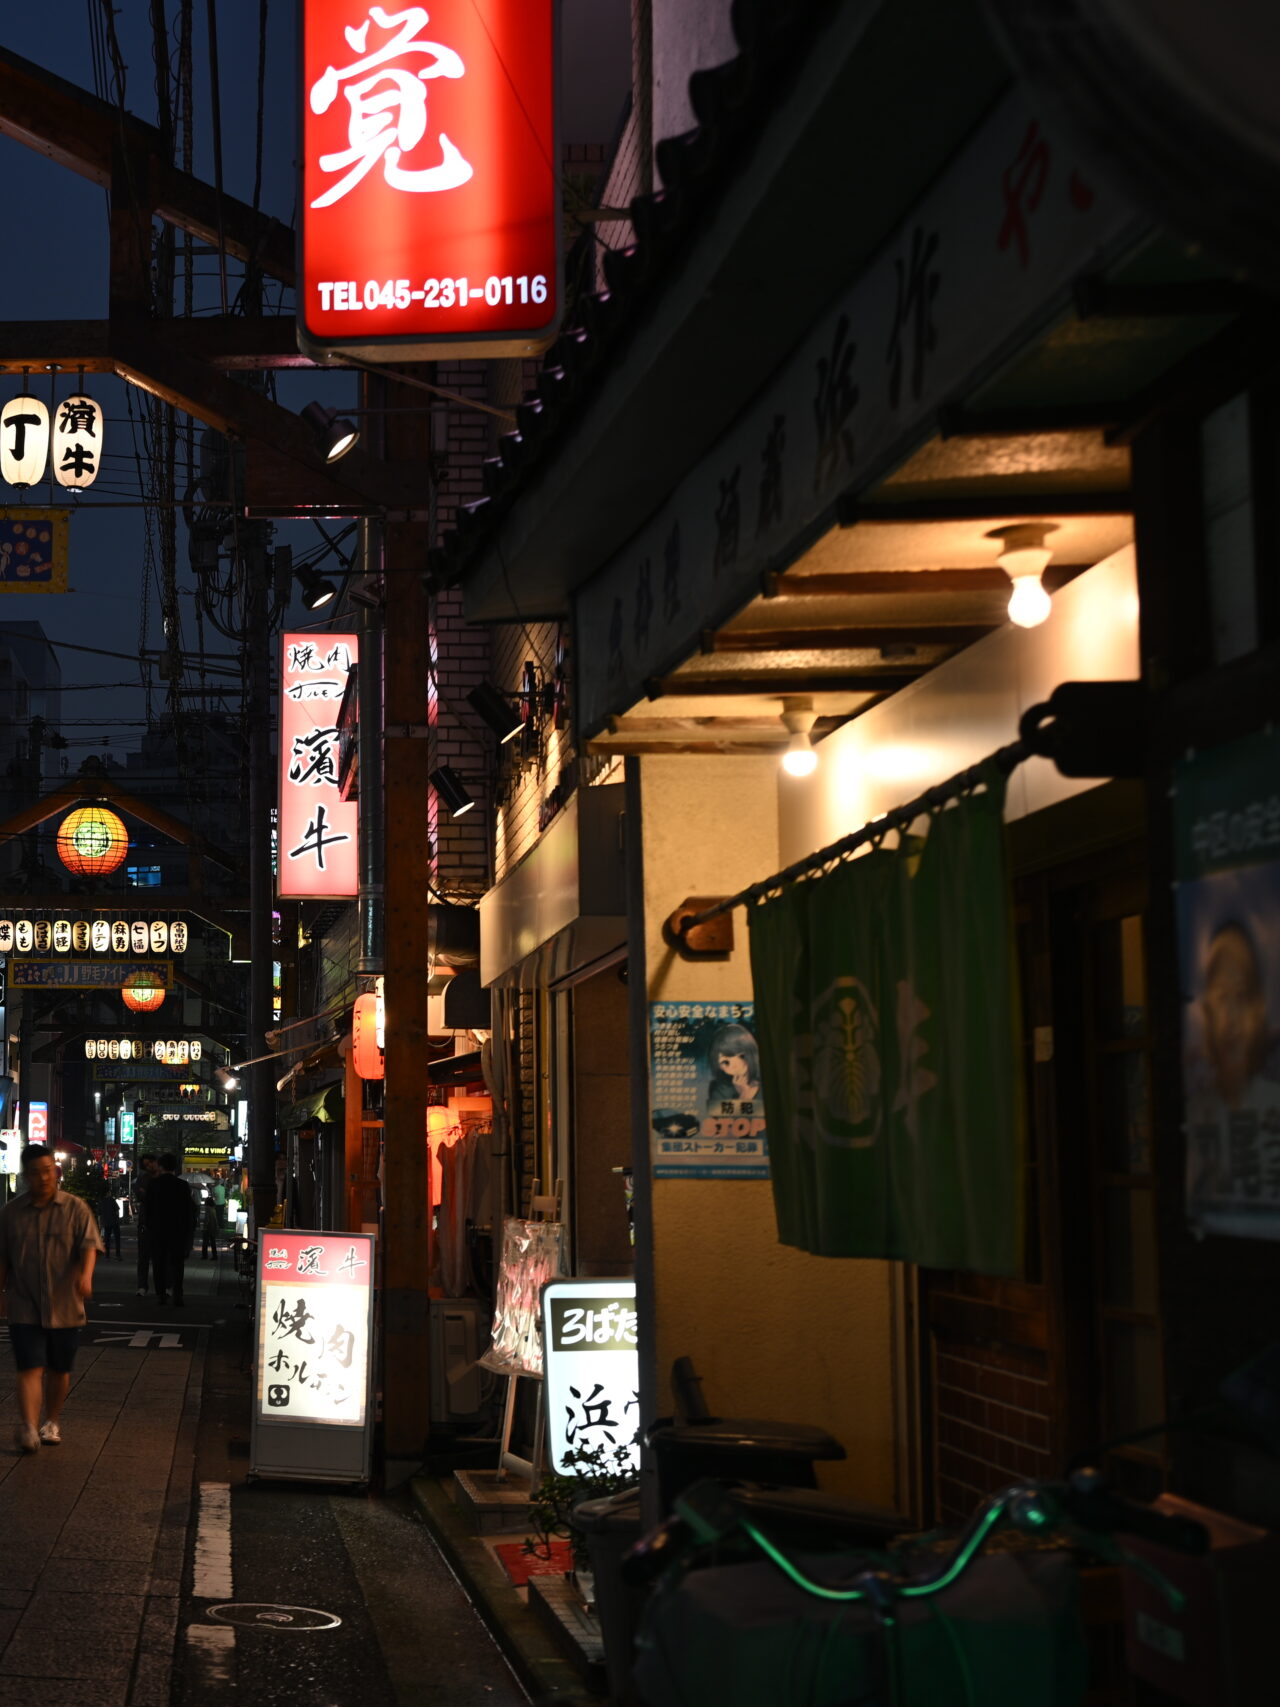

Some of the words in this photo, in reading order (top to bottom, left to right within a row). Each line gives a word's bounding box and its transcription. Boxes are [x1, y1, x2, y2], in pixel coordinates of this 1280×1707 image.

[310, 6, 473, 208] 覚
[318, 275, 548, 311] TEL045-231-0116
[60, 402, 96, 478] 濱牛
[292, 646, 351, 671] 焼肉
[289, 729, 349, 868] 濱牛
[81, 965, 126, 982] 野毛ナイト
[297, 1246, 365, 1276] 濱牛
[271, 1298, 355, 1369] 焼肉
[560, 1302, 638, 1345] ろばた
